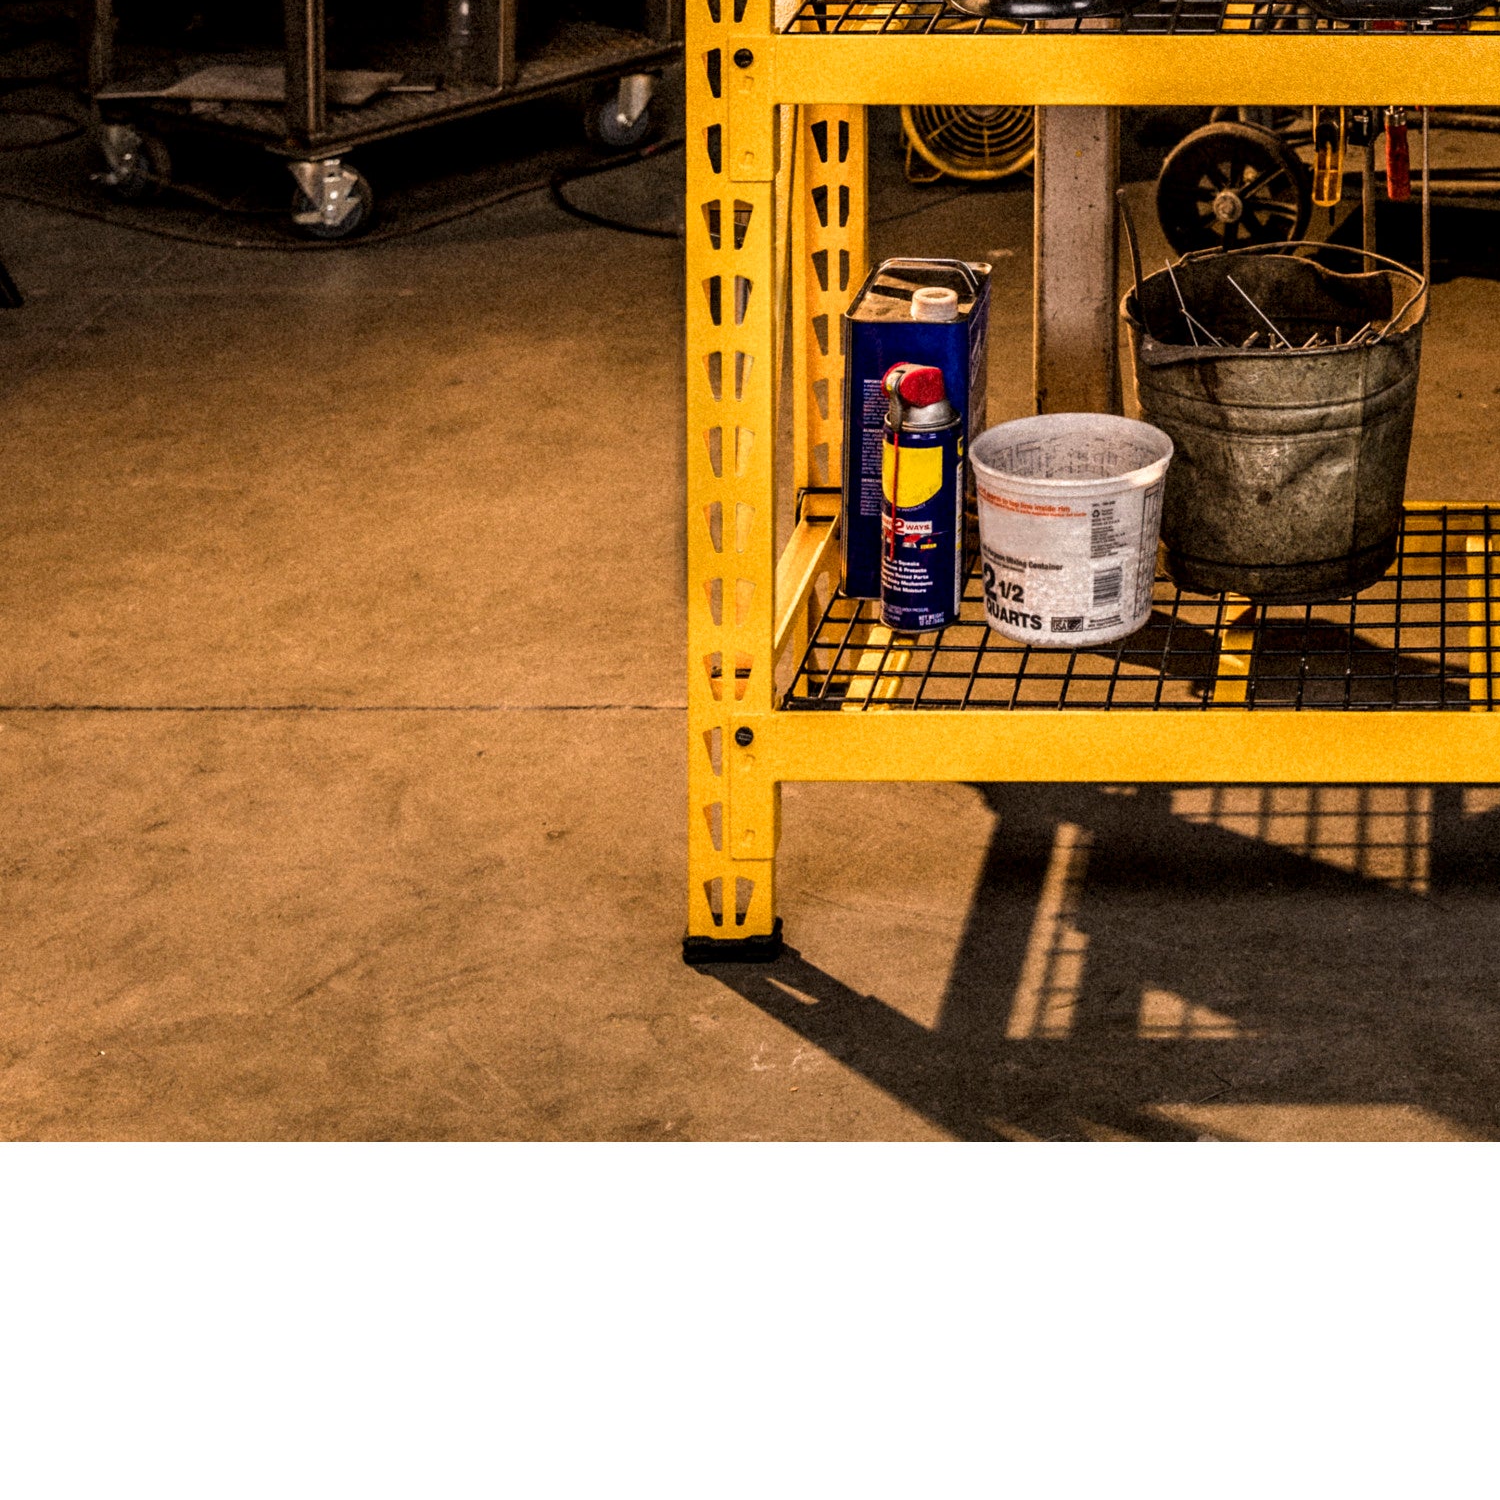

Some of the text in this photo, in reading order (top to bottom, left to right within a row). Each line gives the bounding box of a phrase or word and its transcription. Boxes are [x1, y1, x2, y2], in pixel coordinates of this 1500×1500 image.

[1028, 561, 1063, 571] Container
[983, 562, 1025, 604] 2 1/2
[985, 599, 1043, 631] QUARTS
